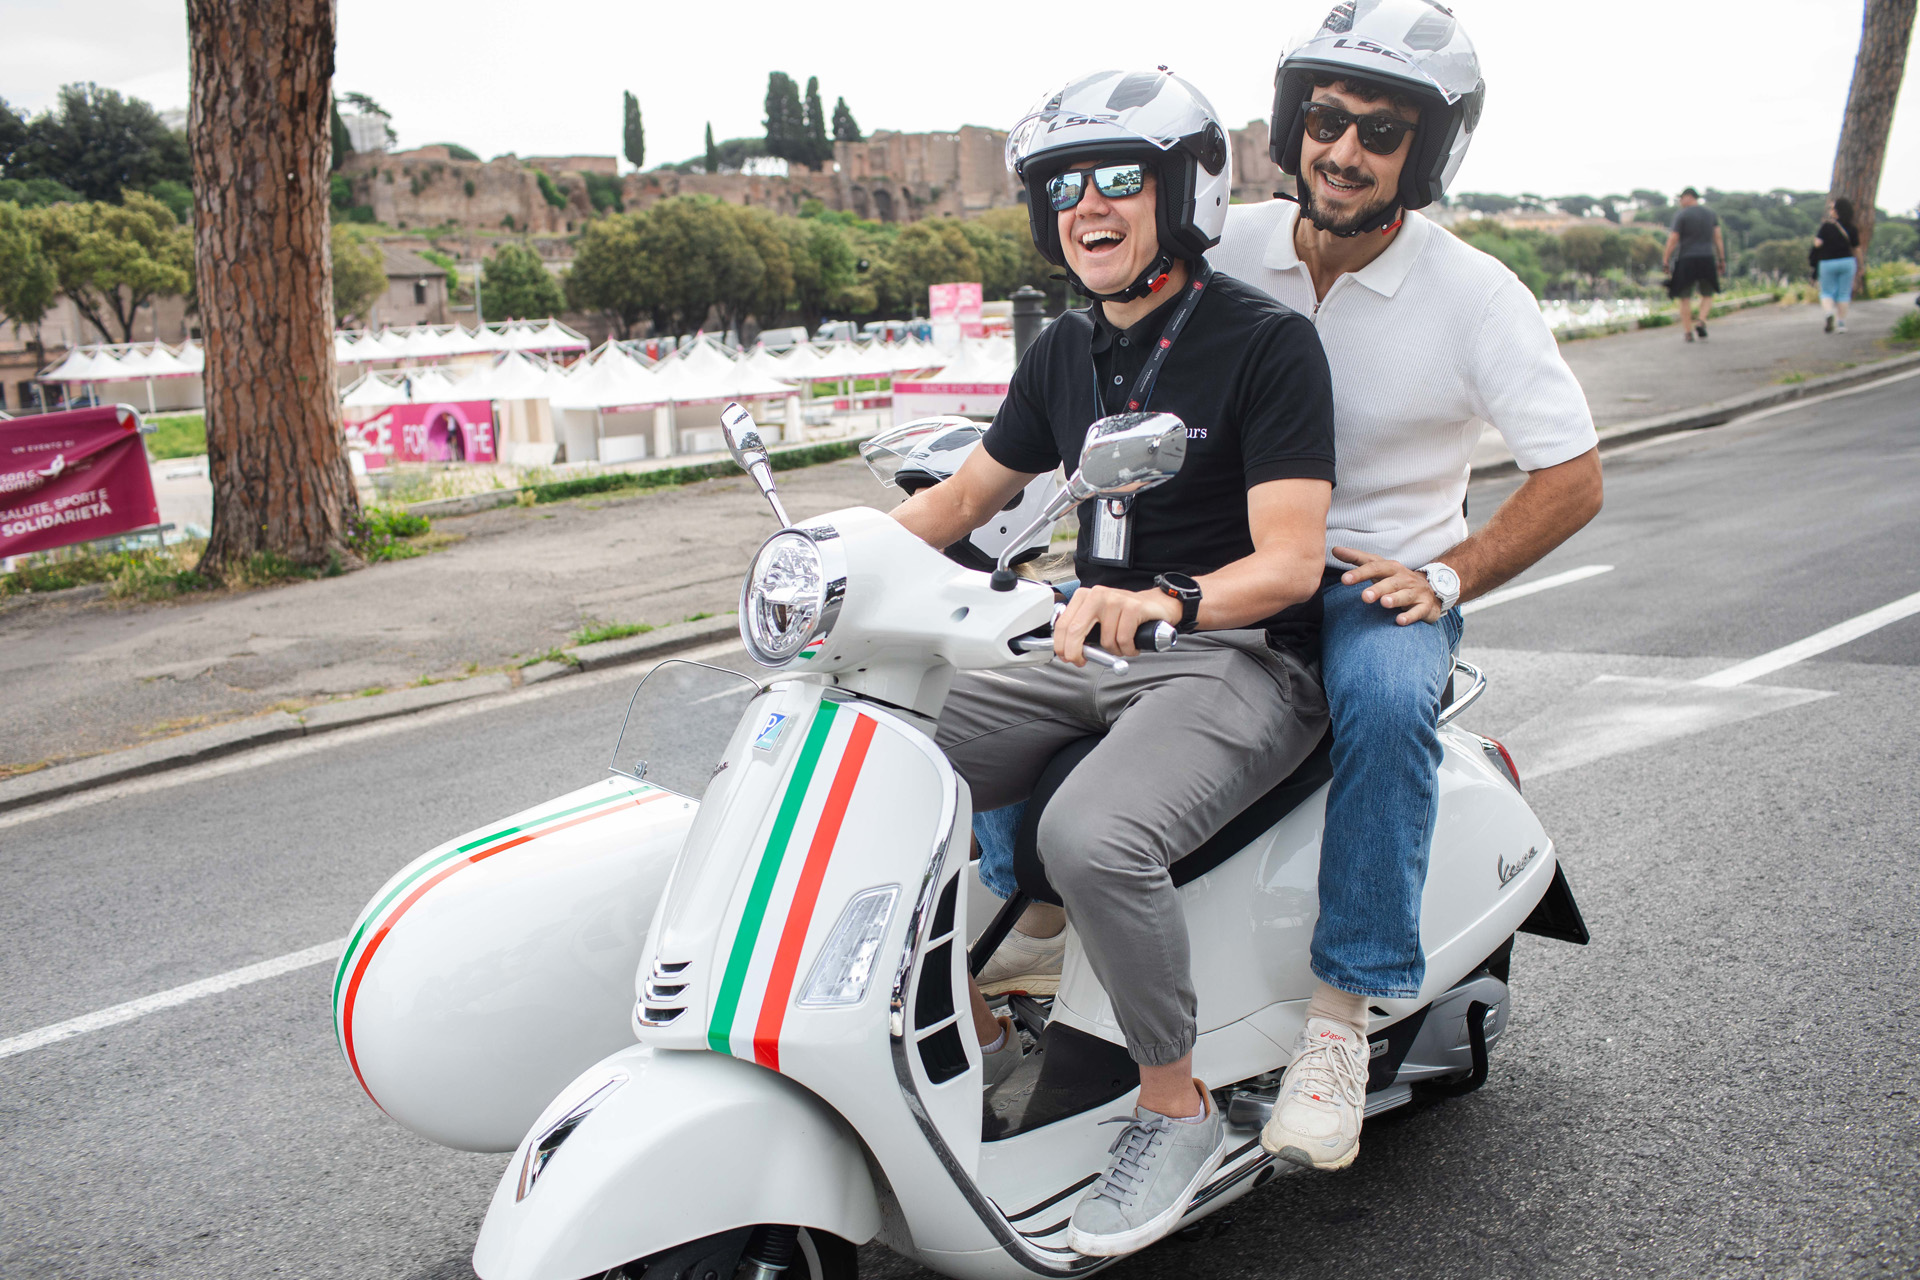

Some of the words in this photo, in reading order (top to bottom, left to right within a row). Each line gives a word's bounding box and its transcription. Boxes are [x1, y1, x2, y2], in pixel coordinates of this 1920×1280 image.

[27, 441, 63, 452] EVENTO
[402, 424, 428, 454] FOR
[464, 422, 492, 454] THE
[54, 490, 96, 510] SPORT
[98, 488, 108, 500] E
[1, 501, 112, 538] SOLIDARIETÀ
